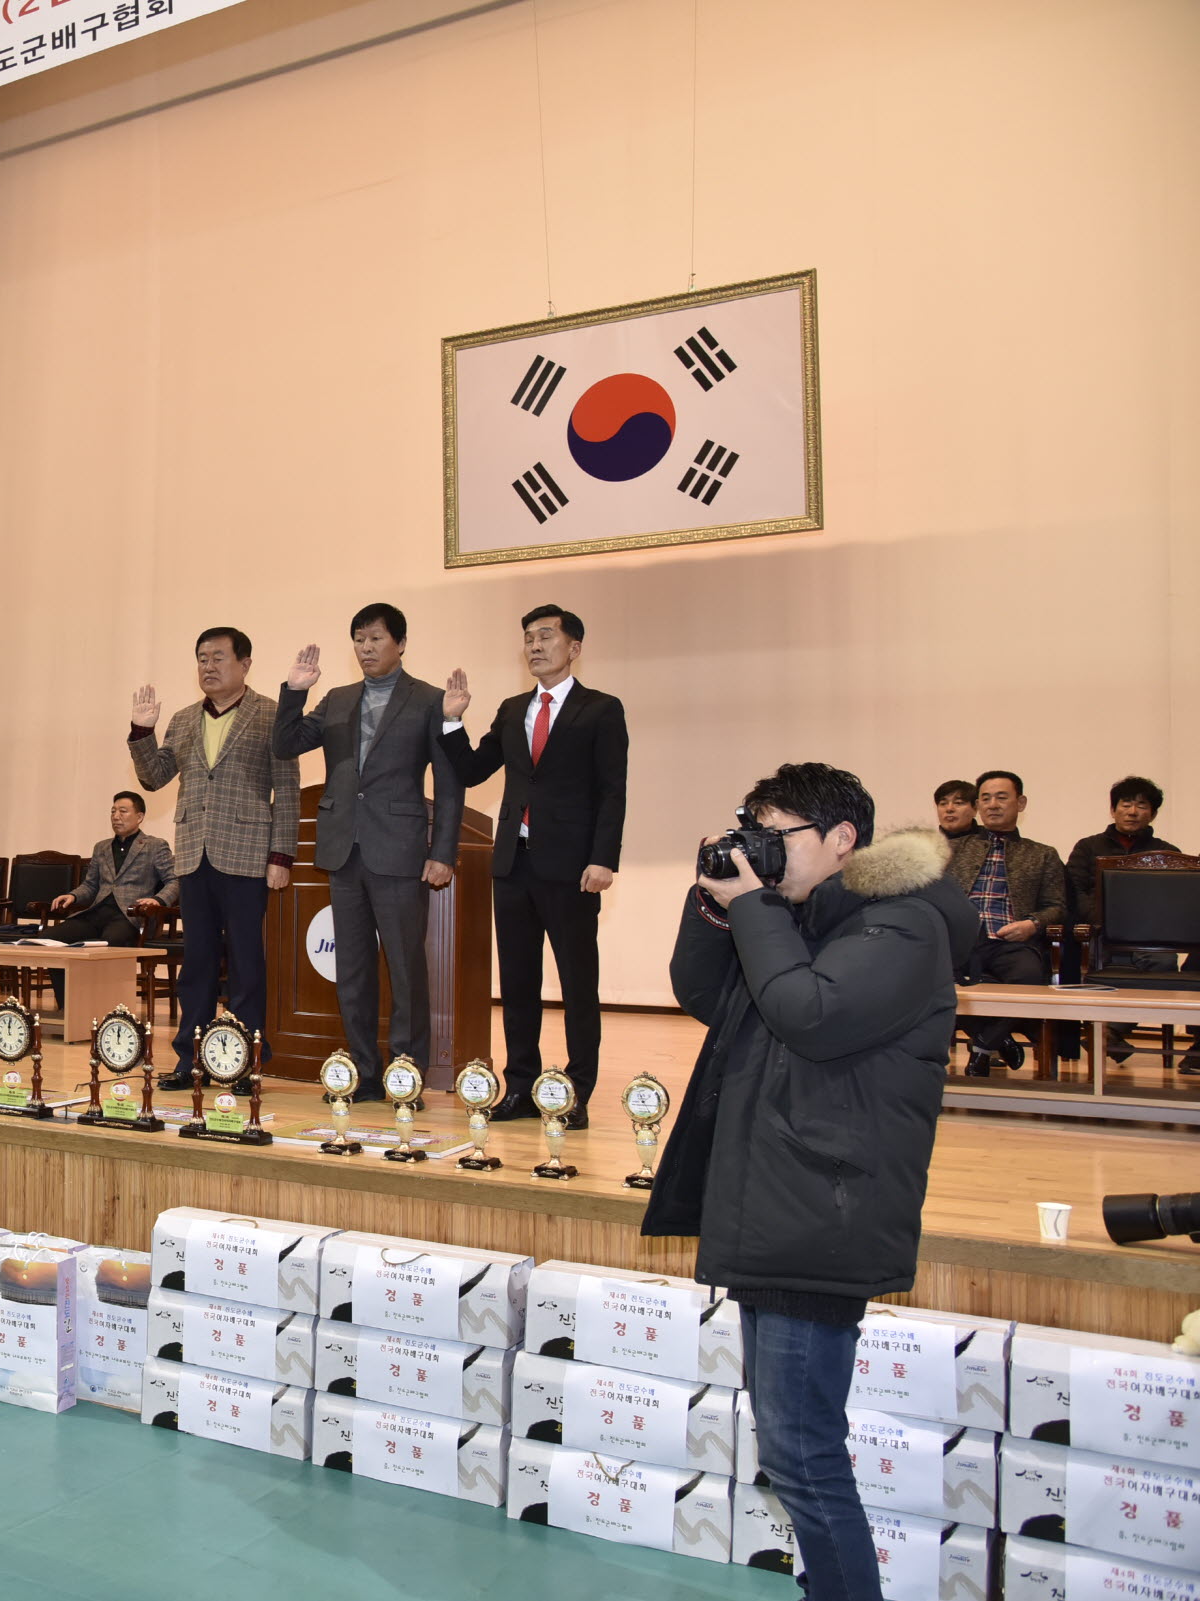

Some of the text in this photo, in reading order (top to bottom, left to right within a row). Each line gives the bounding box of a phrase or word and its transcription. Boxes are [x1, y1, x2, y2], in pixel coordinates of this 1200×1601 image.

[631, 1295, 666, 1307] 진도군수배
[603, 1301, 671, 1320] 전국여자배구대회
[856, 1338, 921, 1353] 여자배구대회
[618, 1383, 655, 1395] 진도군수배
[590, 1388, 659, 1408] 전국여자배구대회
[849, 1433, 909, 1450] 여자배구대회
[867, 1514, 900, 1527] 도군수배
[869, 1526, 906, 1542] 배구대회
